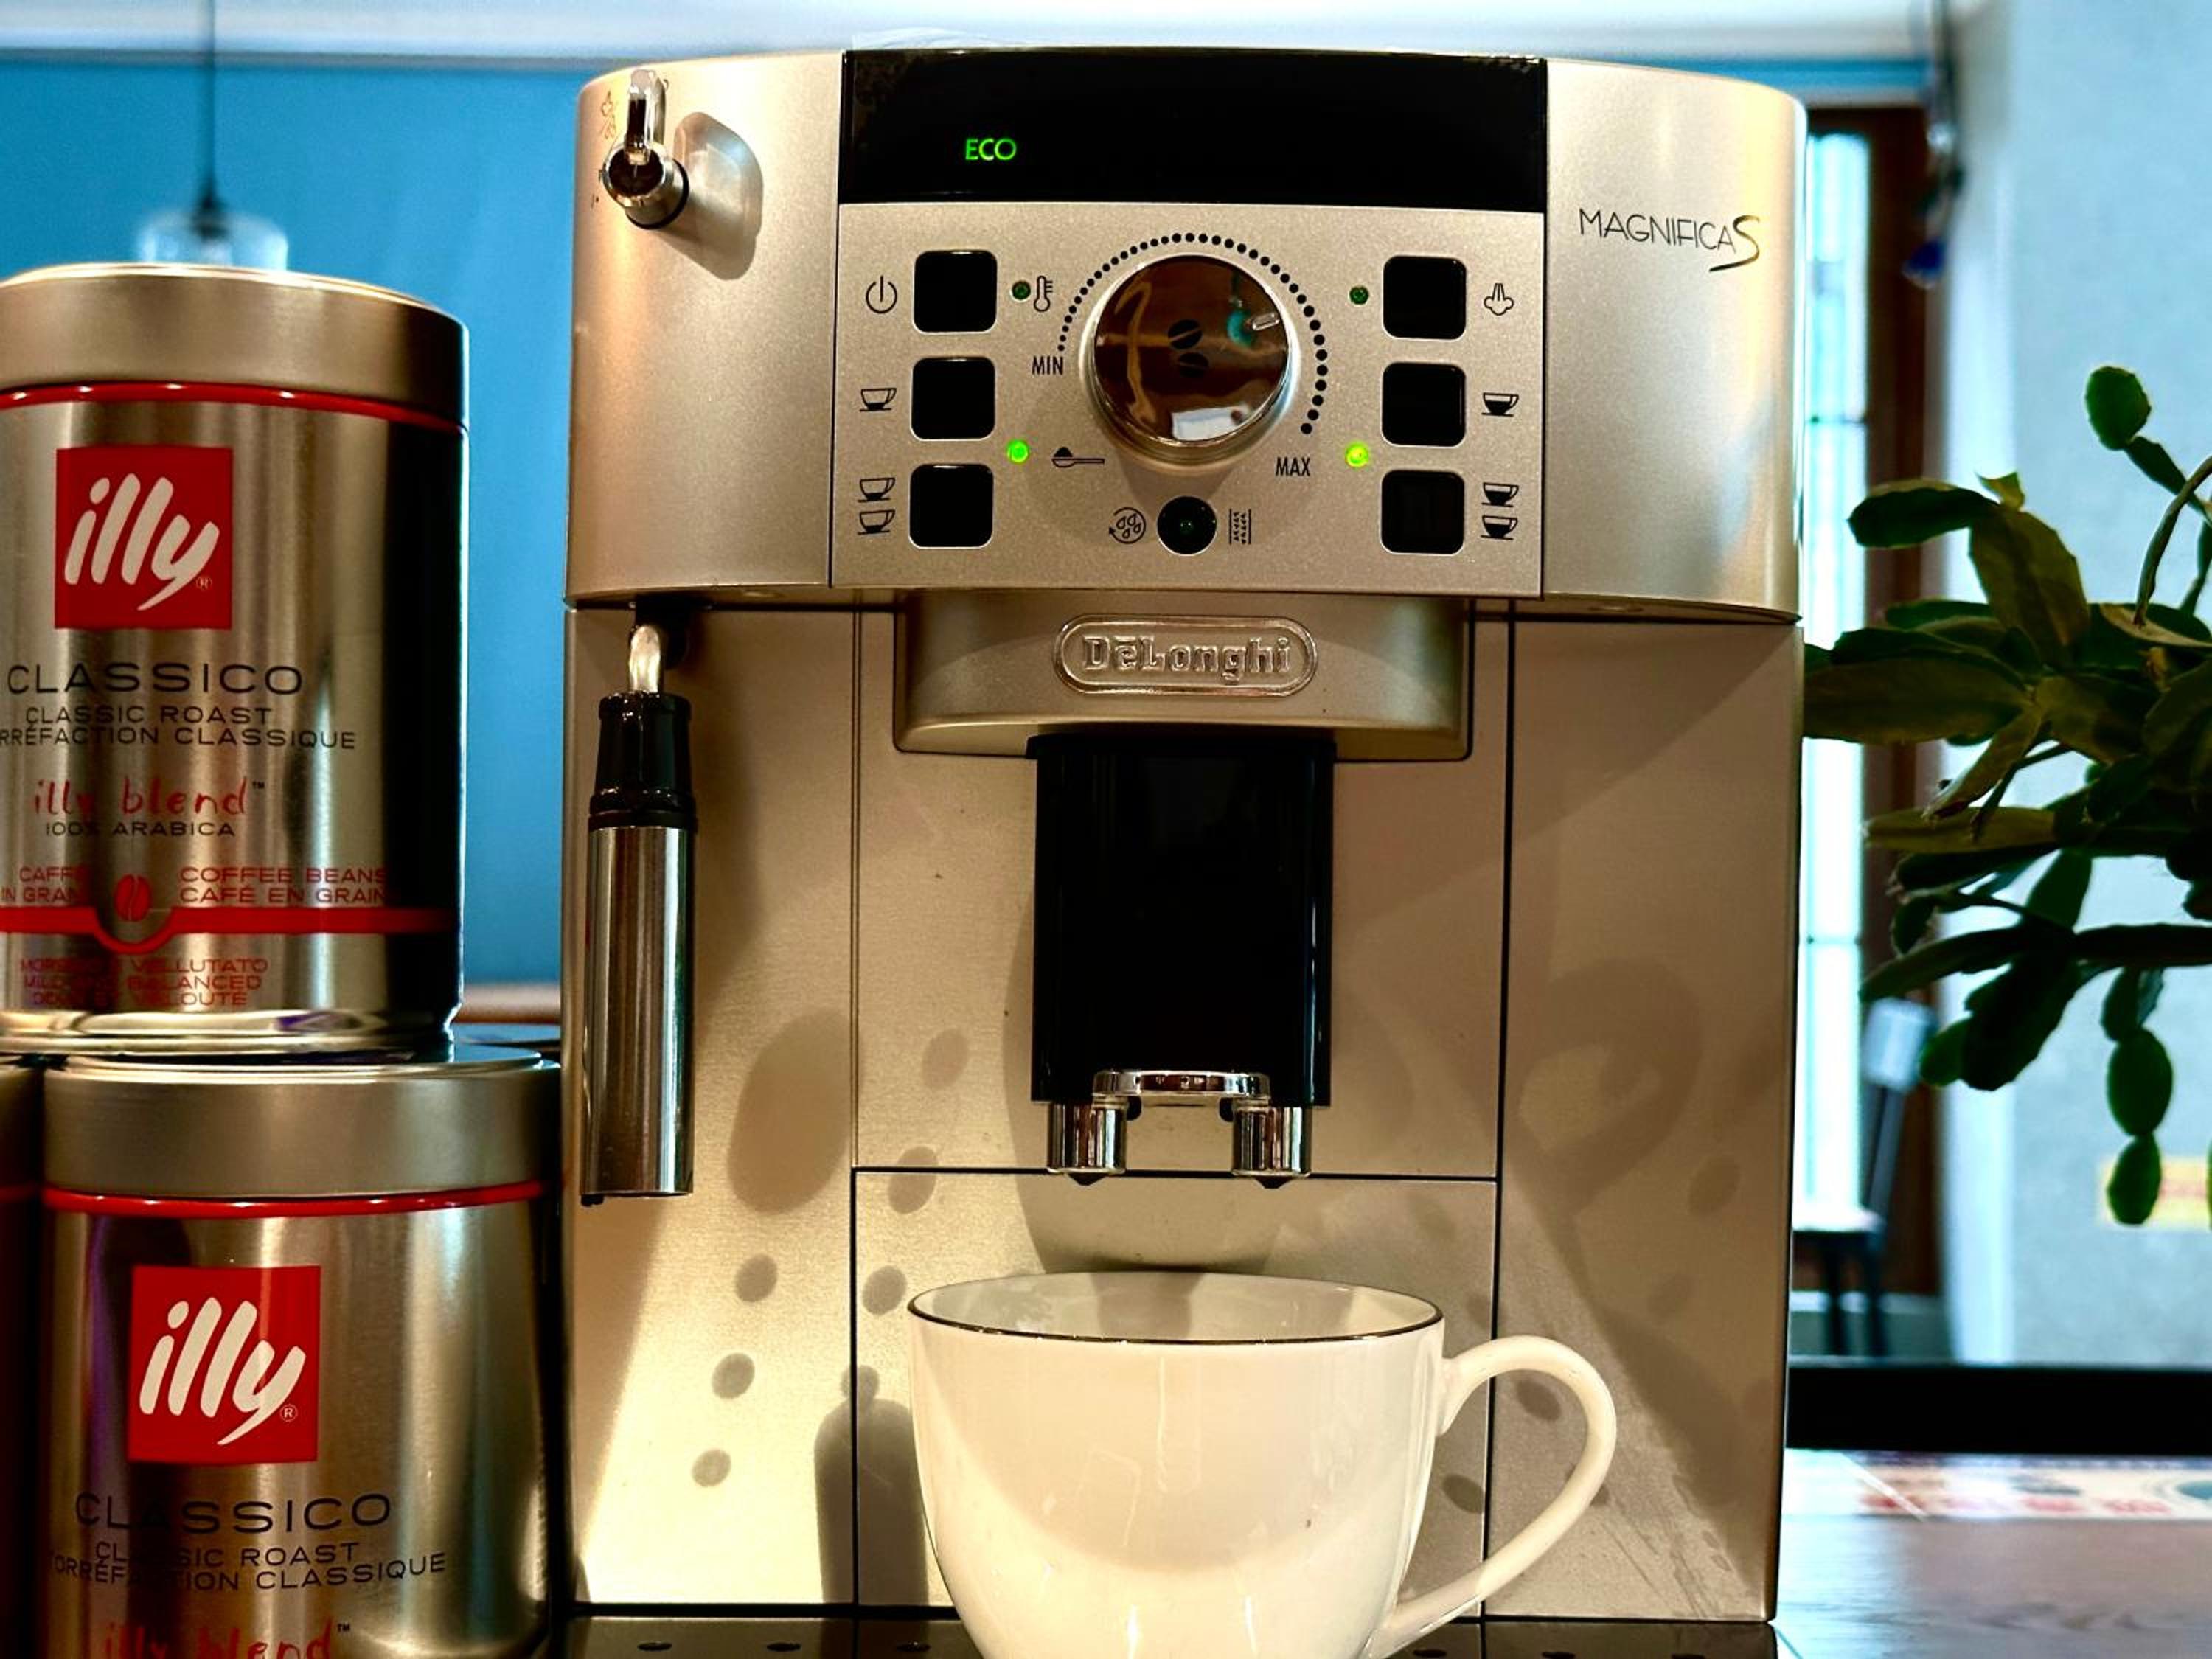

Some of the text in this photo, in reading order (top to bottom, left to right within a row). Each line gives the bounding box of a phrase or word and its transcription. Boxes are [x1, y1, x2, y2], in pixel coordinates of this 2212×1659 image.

[965, 137, 1017, 161] ECO
[1032, 355, 1064, 375] MIN
[1275, 457, 1311, 476] MAX
[63, 473, 220, 611] illy
[7, 663, 302, 695] CLASSICO
[26, 706, 272, 725] CLASSIC ROAST
[175, 727, 355, 750] CLASSIQUE
[35, 774, 248, 821] illy blend
[112, 821, 236, 837] ARABICA
[19, 866, 386, 883] CAFF COFFEE BEANS
[23, 886, 88, 903] GRA
[268, 887, 305, 903] EN
[131, 958, 268, 973] VLUTATO
[128, 975, 262, 990] BANCED
[139, 1296, 307, 1445] illy
[75, 1491, 391, 1534] CLASSICO
[96, 1540, 359, 1568] CLSIC ROAST
[256, 1552, 445, 1590] CLASSIQUE
